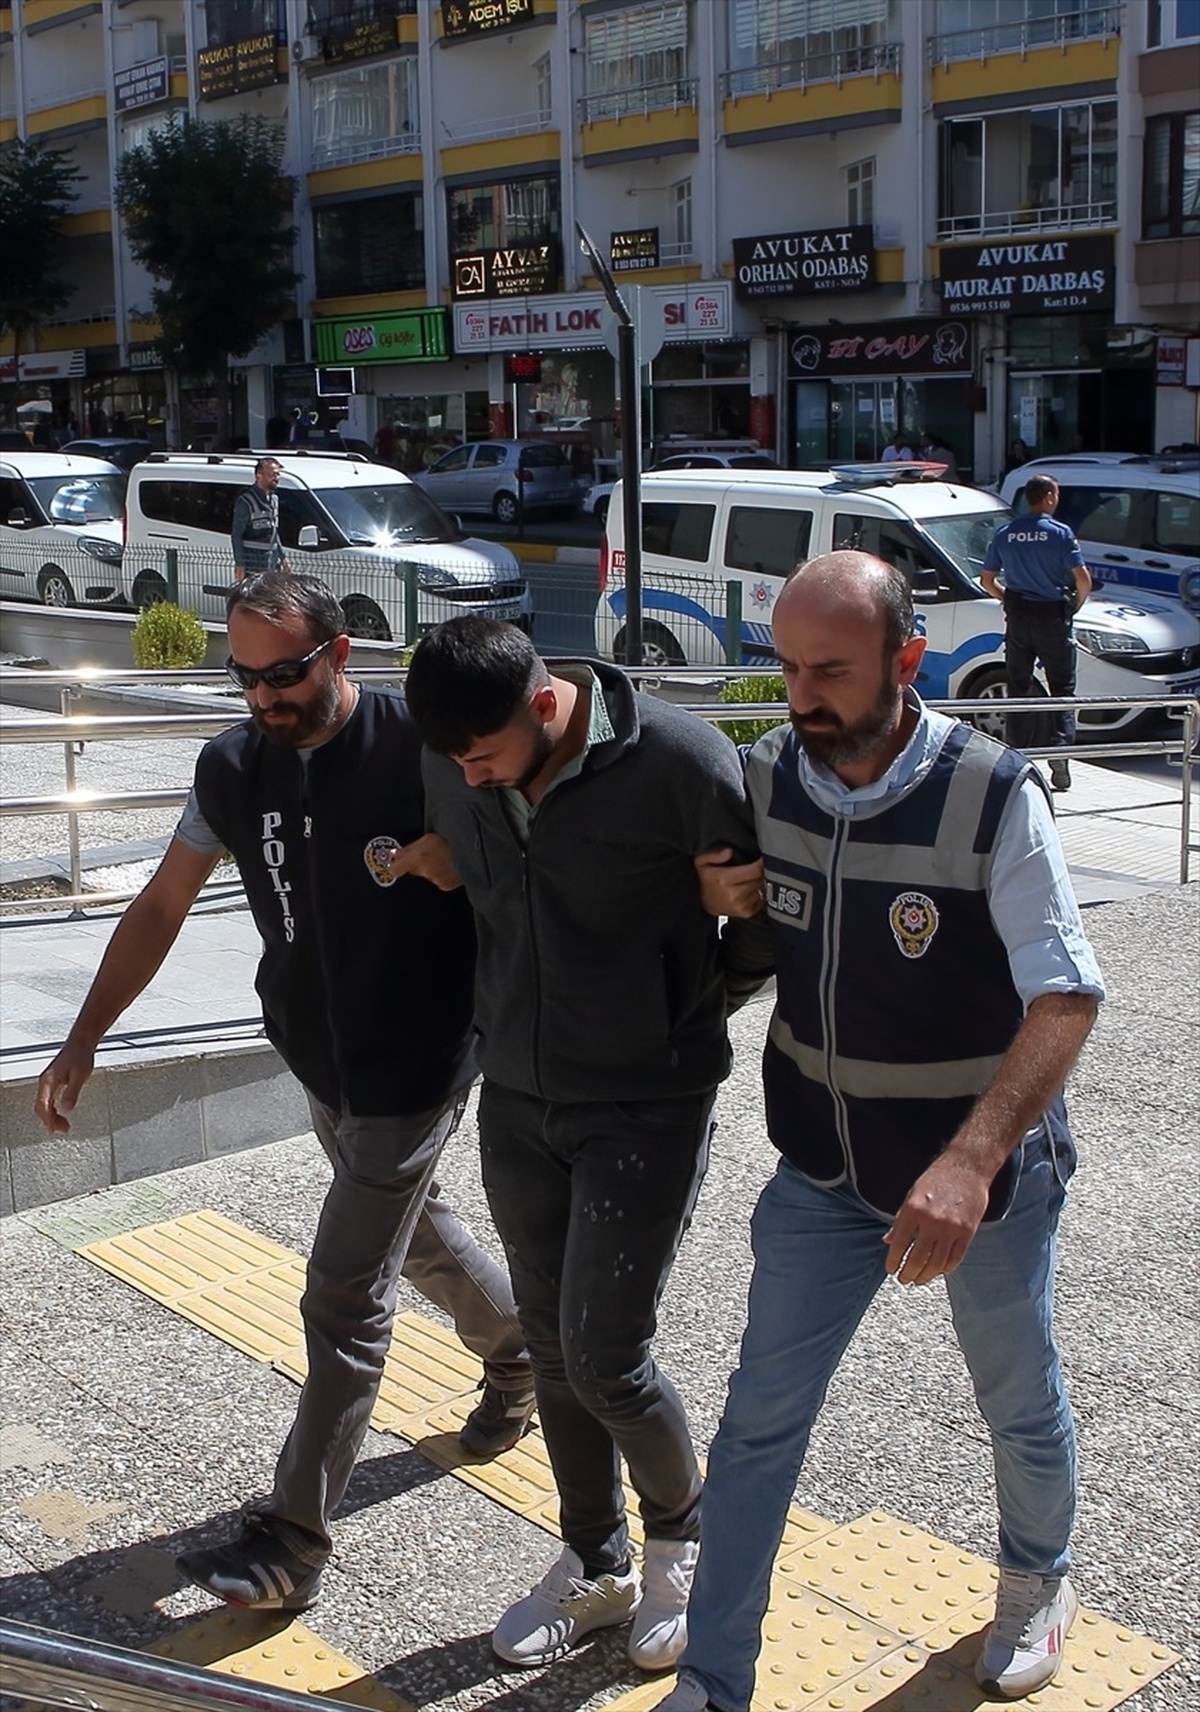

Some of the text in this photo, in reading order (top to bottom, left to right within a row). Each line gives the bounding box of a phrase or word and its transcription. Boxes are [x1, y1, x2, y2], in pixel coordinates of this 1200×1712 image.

[469, 4, 503, 23] ADEM
[199, 45, 235, 67] AVUKAT
[236, 34, 275, 57] AVUKAT
[491, 246, 551, 270] AYVAZ
[751, 232, 853, 261] AVUKAT
[977, 242, 1068, 267] AVUKAT
[739, 254, 869, 284] ORHAN ODABAŞ
[943, 269, 1106, 299] MURAT DARBAŞ
[489, 309, 548, 336] FATİH
[766, 882, 802, 915] LiS
